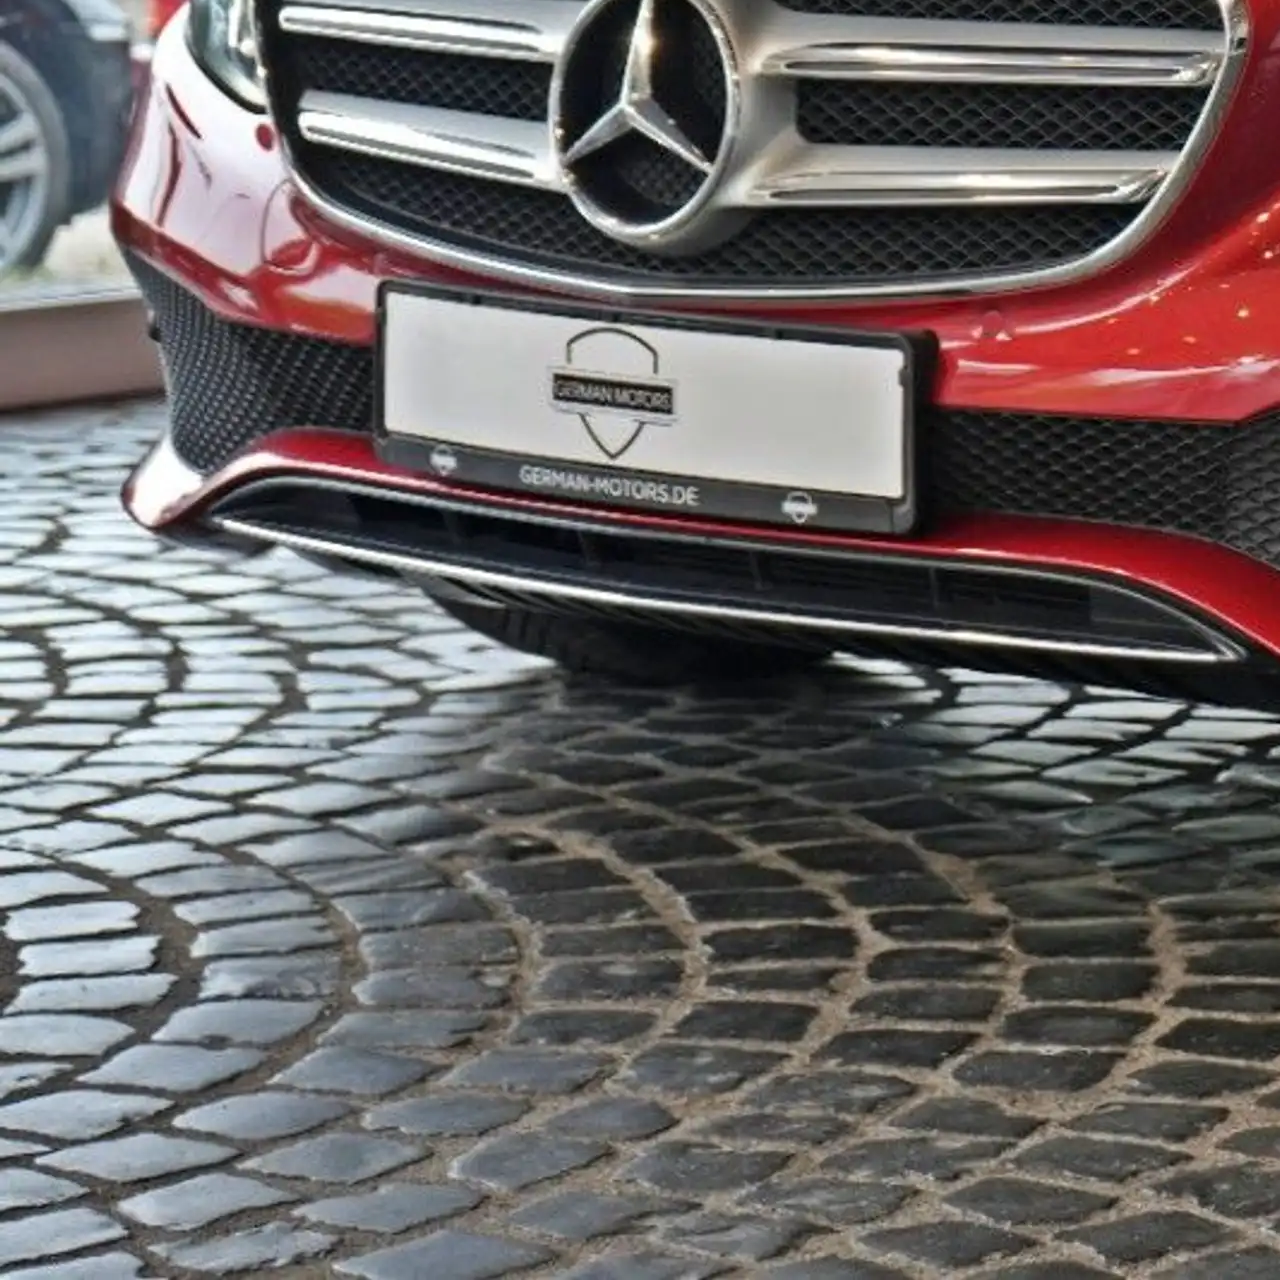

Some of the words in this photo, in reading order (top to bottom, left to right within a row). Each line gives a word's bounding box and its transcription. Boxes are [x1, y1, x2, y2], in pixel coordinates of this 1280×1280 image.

[555, 380, 613, 403] GERMAN
[615, 387, 672, 409] MOTORS
[519, 465, 699, 506] GERMAN-MOTORS.DE
